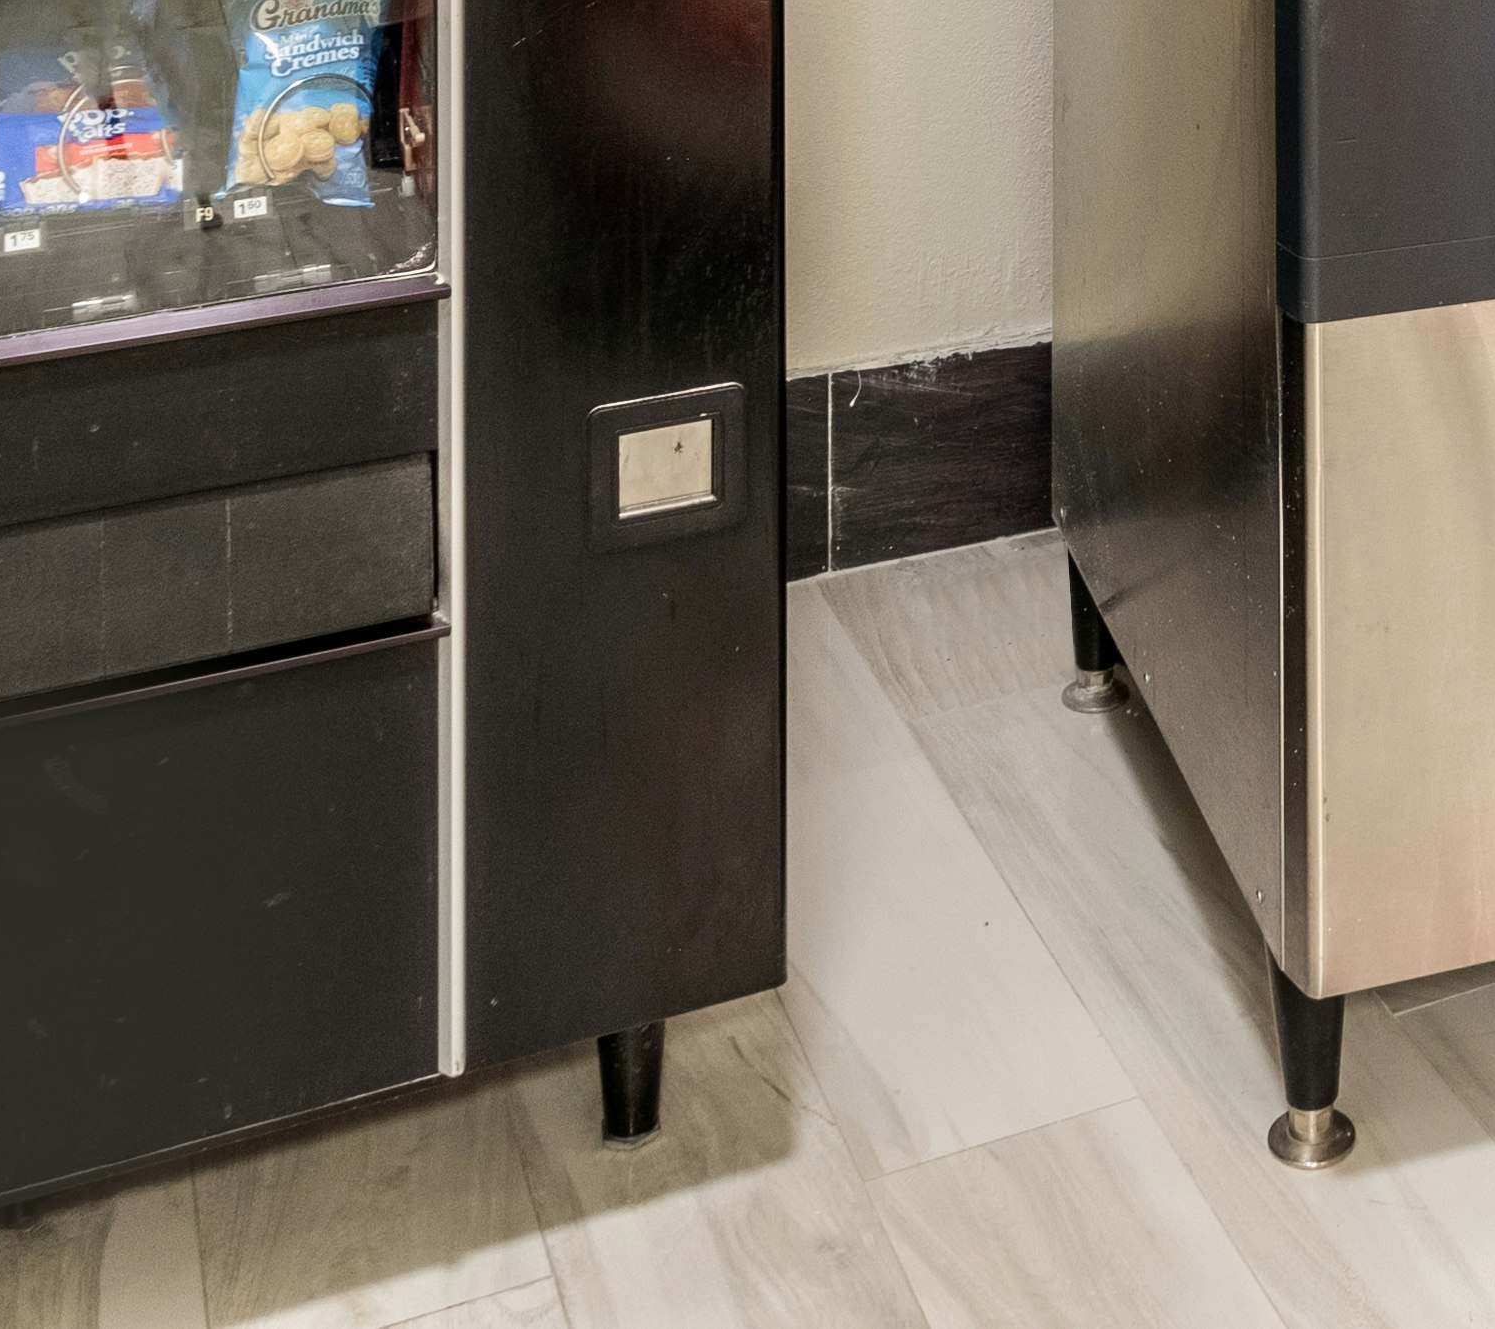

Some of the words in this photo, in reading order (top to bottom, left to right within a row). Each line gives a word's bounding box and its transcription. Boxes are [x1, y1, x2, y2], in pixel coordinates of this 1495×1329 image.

[264, 30, 365, 62] Sandwich
[270, 45, 361, 78] Cremes
[195, 207, 215, 223] F9
